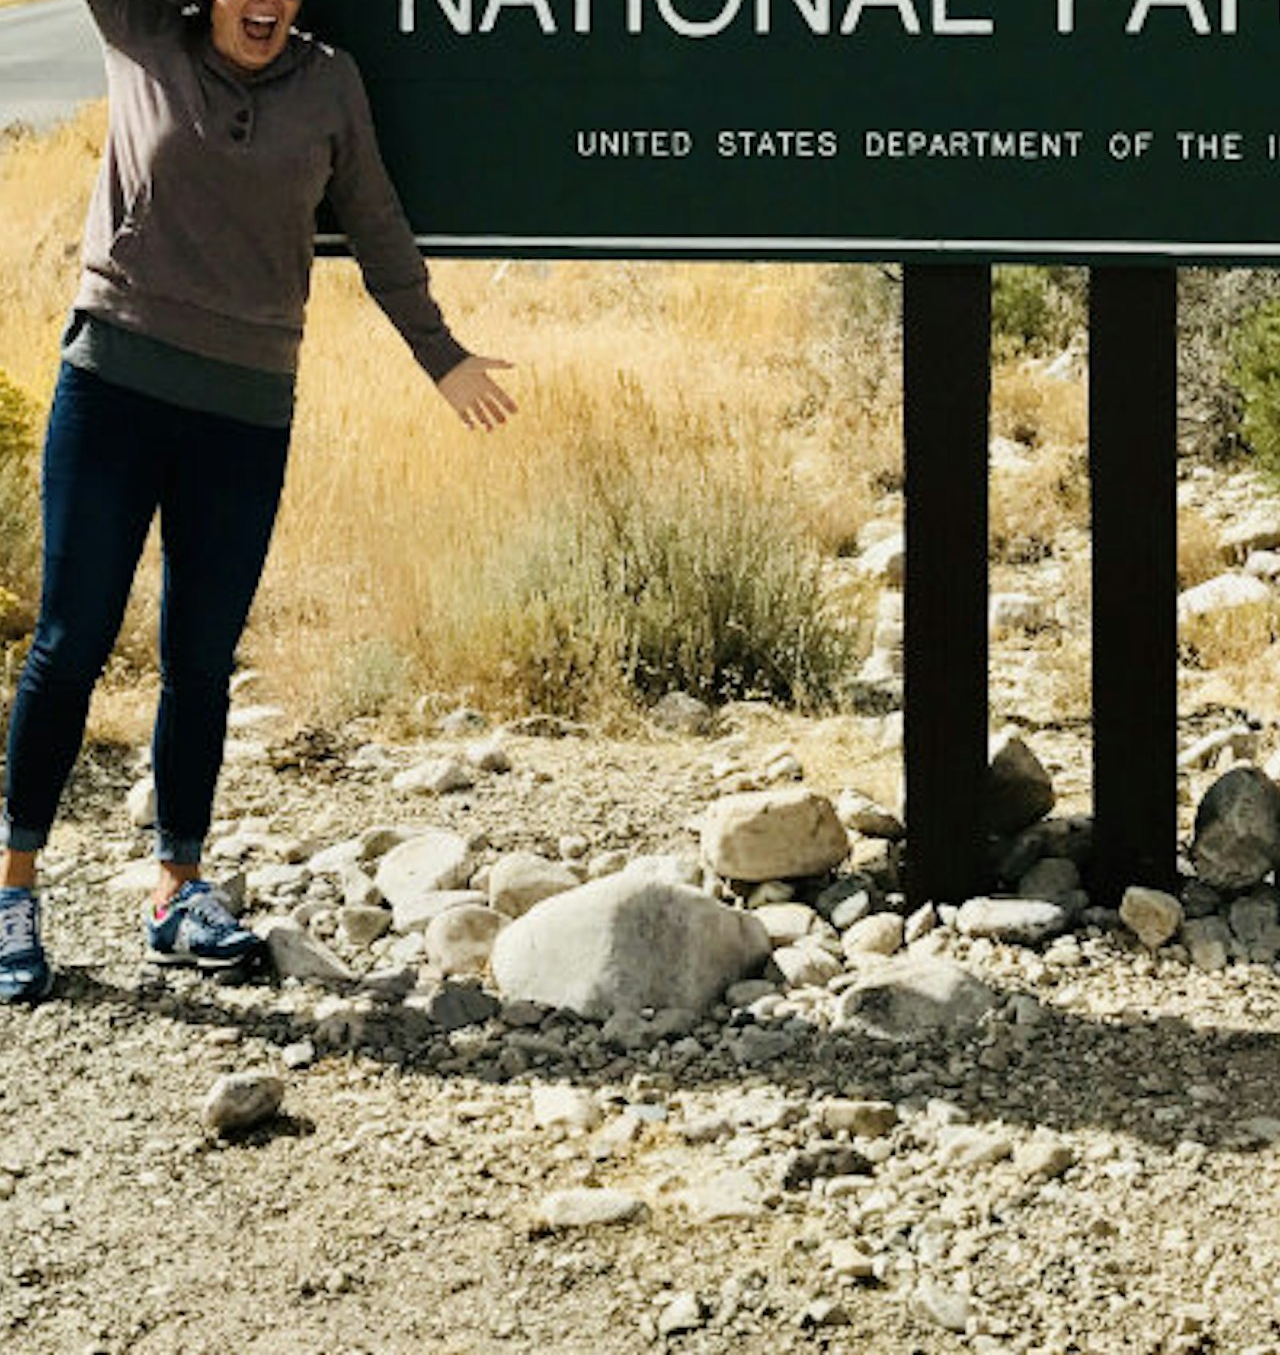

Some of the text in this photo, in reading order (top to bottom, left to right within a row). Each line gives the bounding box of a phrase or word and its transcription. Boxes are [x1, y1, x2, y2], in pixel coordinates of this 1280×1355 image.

[577, 131, 692, 157] UNITED
[718, 131, 837, 157] STATES
[865, 131, 1083, 158] DEPARTMENT
[1108, 132, 1153, 160] OF
[1176, 132, 1243, 160] THE
